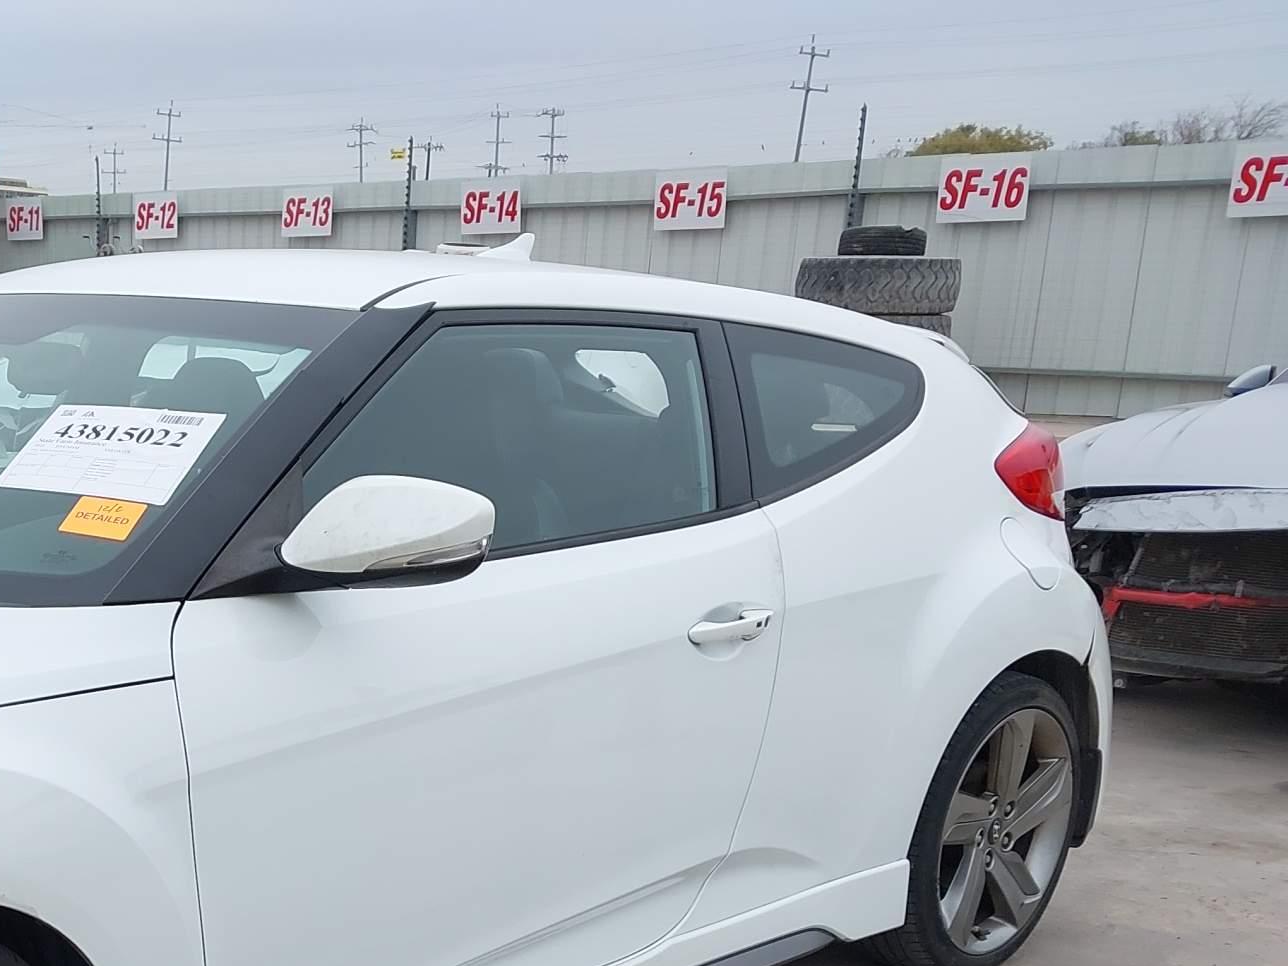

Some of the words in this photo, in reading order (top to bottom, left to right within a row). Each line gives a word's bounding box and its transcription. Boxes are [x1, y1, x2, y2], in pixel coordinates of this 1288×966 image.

[655, 181, 726, 220] SF-15
[940, 166, 1028, 211] SF-16
[8, 206, 40, 232] SF-11
[136, 201, 176, 231] SF-12
[283, 196, 332, 228] SF-13
[463, 190, 519, 224] SF-14
[54, 423, 189, 448] 43815022
[75, 511, 130, 525] DETAILED
